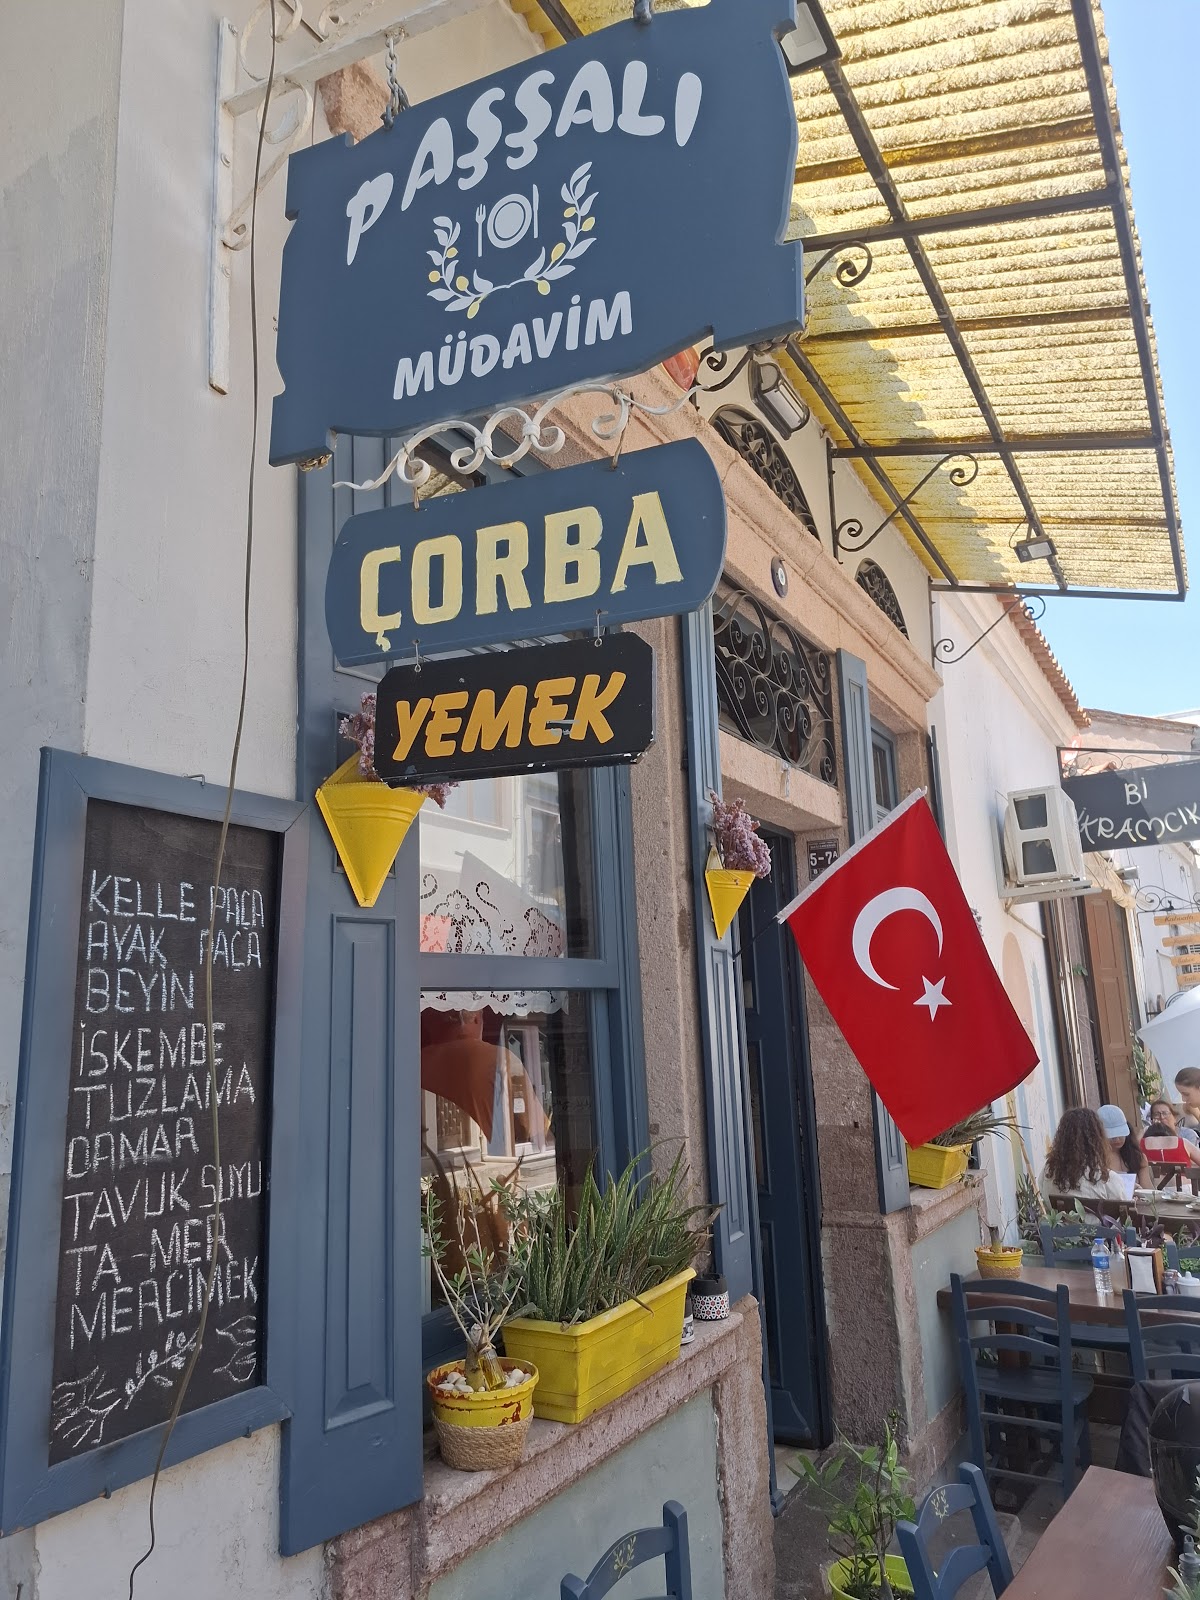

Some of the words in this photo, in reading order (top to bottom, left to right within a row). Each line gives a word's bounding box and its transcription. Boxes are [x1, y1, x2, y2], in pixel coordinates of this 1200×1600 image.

[346, 60, 703, 266] PAŞŞALI
[393, 290, 633, 401] MÜDAVİM
[360, 491, 684, 652] ÇORBA
[392, 671, 627, 762] YEMEK
[88, 869, 197, 922] KELLE
[86, 920, 169, 968] AYAK
[73, 1062, 257, 1130] TUZLAMA
[66, 1116, 199, 1180] DAMAR
[64, 1168, 190, 1242] TAVUK
